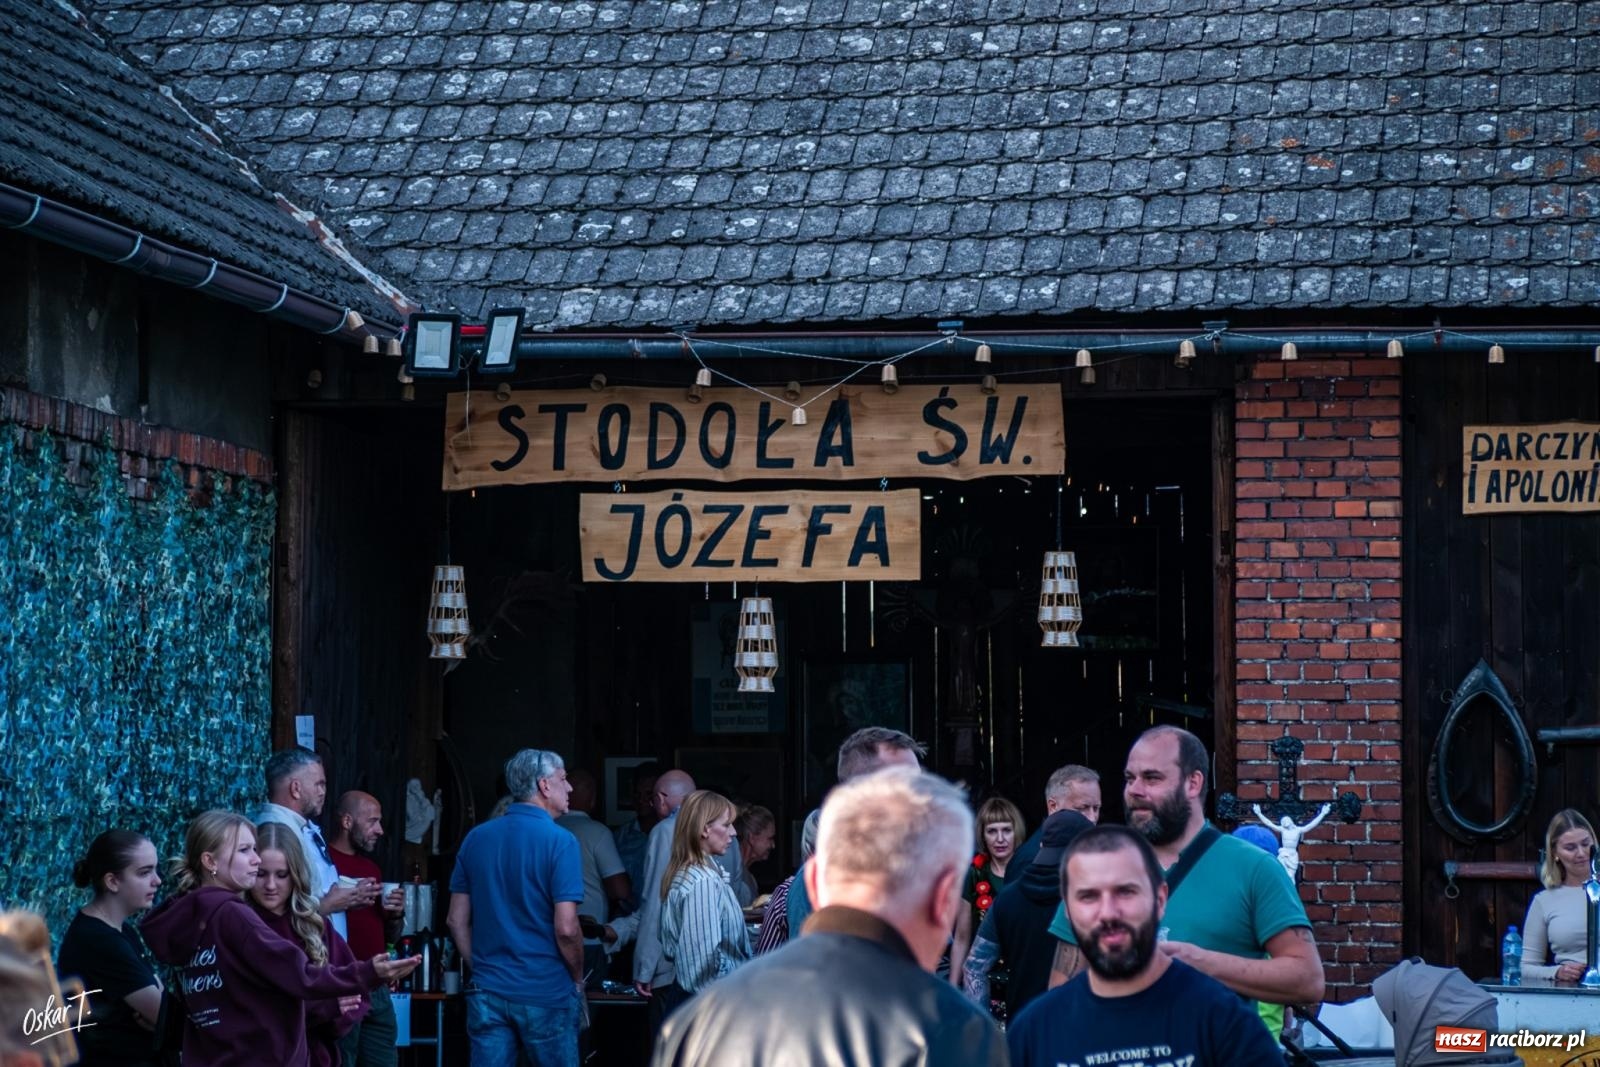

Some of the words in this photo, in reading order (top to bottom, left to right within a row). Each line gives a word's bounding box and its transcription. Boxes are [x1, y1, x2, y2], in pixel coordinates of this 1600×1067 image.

[490, 398, 854, 473] STODOŁA
[917, 385, 1034, 467] ŚW.
[1485, 462, 1600, 504] APOLONI
[593, 491, 891, 581] JÓZEFA
[1085, 1047, 1150, 1065] WELCOME
[1153, 1045, 1172, 1057] TO
